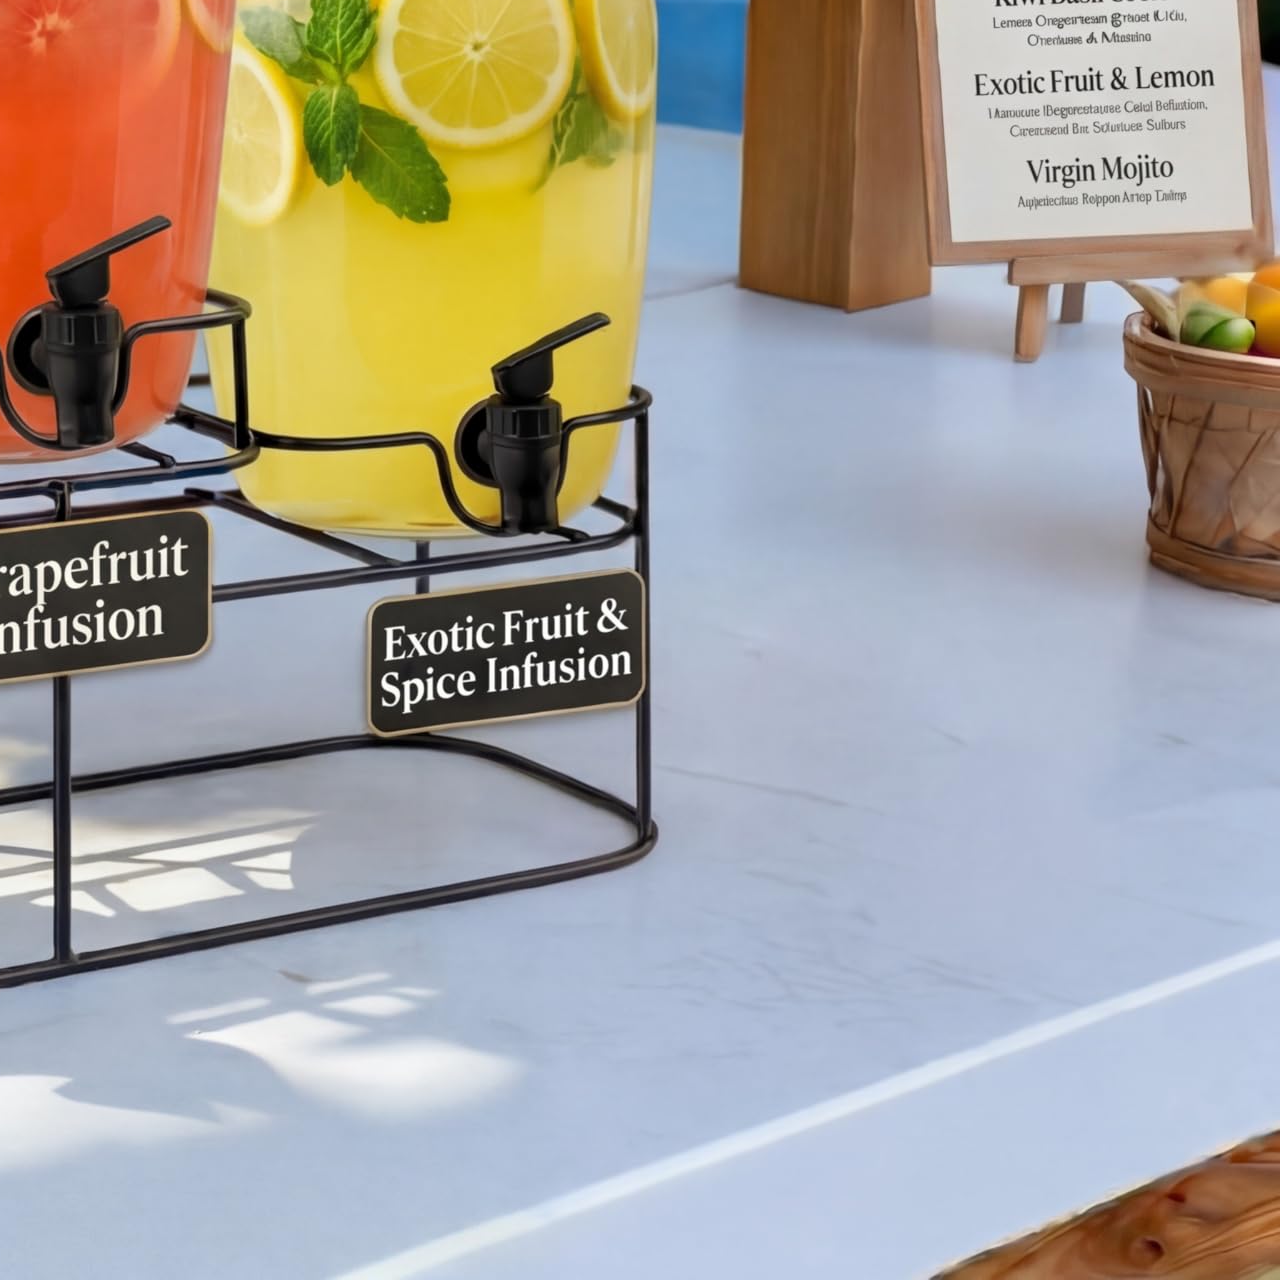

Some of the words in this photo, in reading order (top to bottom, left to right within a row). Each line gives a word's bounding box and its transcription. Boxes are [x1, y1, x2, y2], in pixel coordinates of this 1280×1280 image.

[974, 70, 1045, 96] Exotic
[1050, 67, 1104, 93] Fruit
[1110, 67, 1129, 91] &
[1135, 66, 1215, 90] Lemon
[1026, 157, 1096, 189] Virgin
[1101, 154, 1174, 187] Mojito
[383, 615, 495, 663] Exotic
[502, 602, 590, 647] Fruit
[596, 597, 629, 633] &
[380, 666, 476, 714] Spice
[486, 646, 633, 694] Infusion
